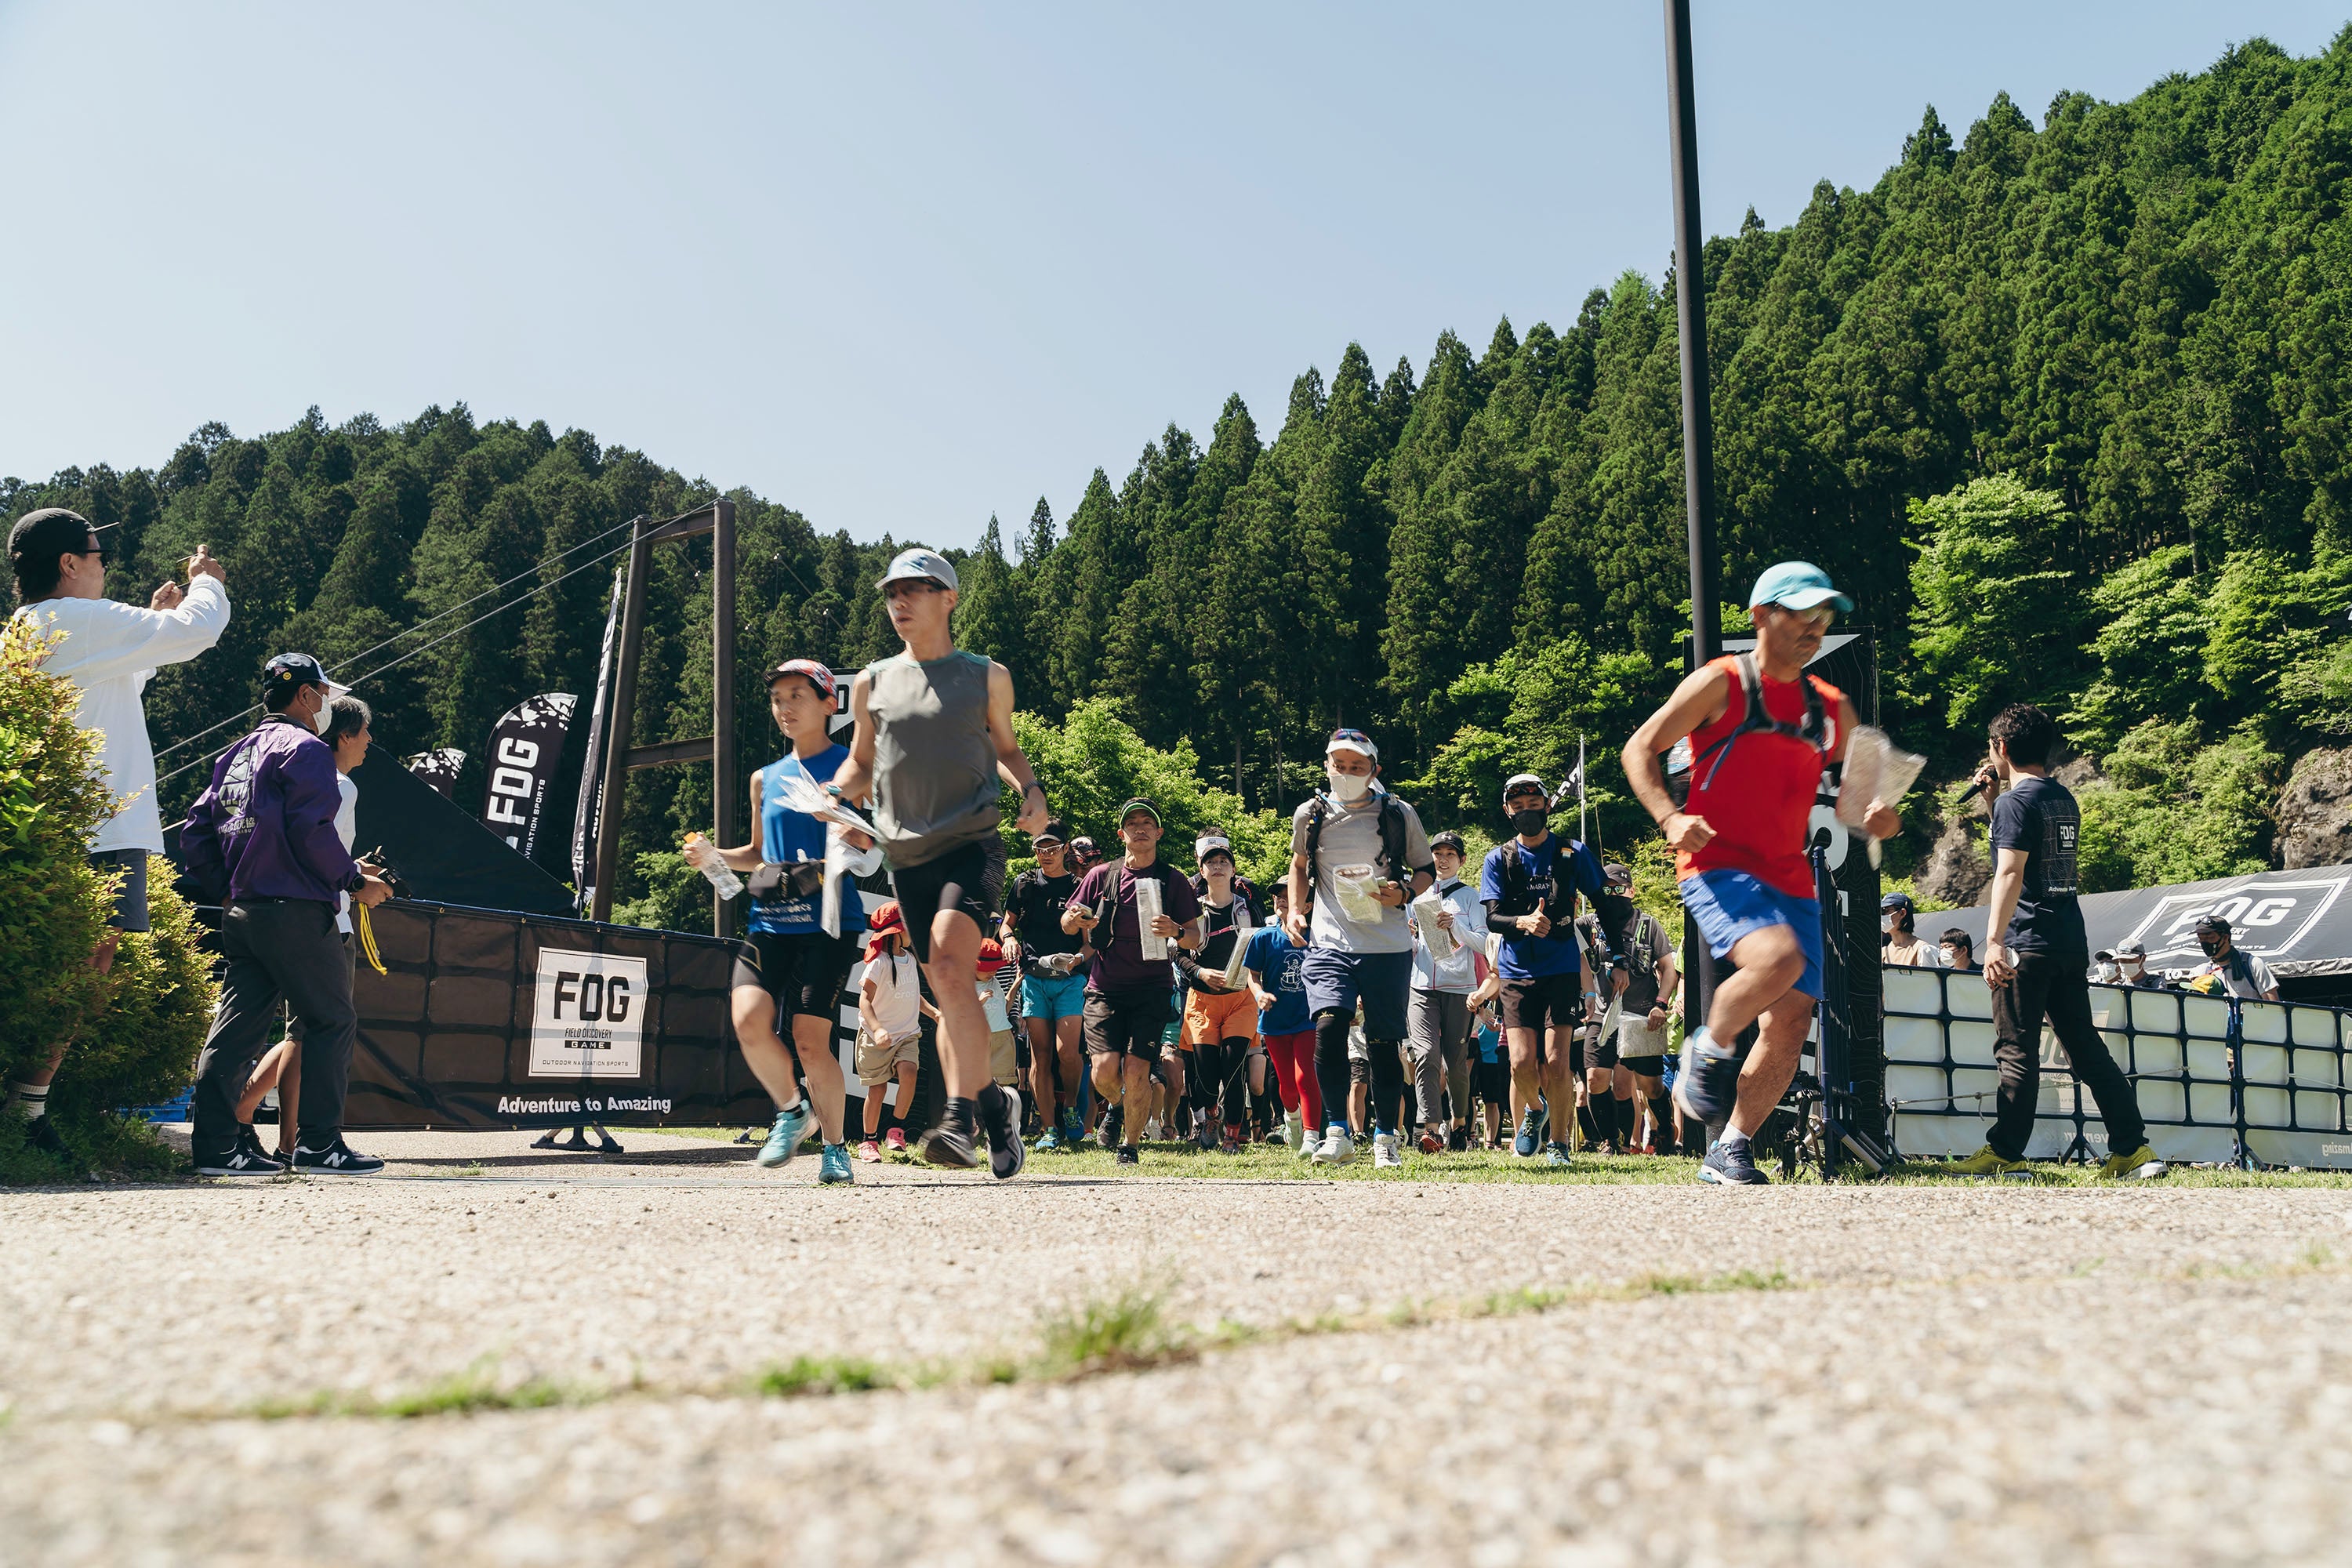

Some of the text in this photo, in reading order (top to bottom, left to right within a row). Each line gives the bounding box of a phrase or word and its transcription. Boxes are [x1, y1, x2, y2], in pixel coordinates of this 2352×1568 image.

[525, 779, 546, 859] VIGATION SPORTS
[564, 1028, 612, 1039] FIELD DISCOVERY
[497, 1096, 672, 1114] Adventure to Amazing
